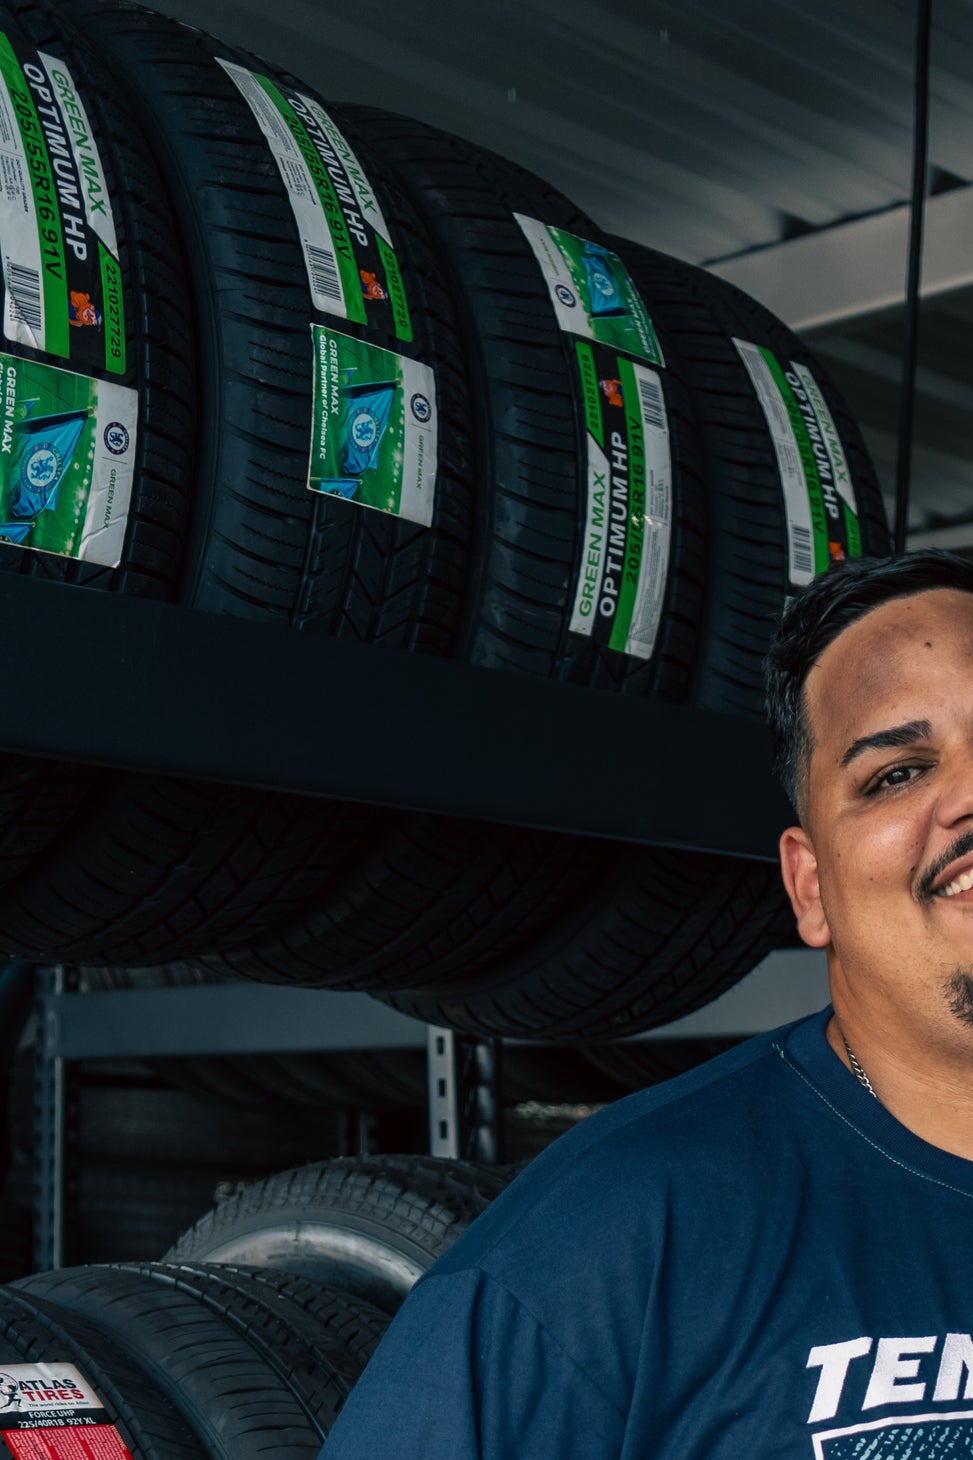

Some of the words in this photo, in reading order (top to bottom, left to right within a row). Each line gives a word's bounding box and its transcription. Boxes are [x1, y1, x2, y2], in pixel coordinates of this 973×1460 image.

[23, 62, 81, 209] OPTIMUM
[63, 212, 88, 261] HP
[52, 69, 92, 151] GREEN
[80, 153, 107, 216] MAX
[310, 105, 355, 165] GREEN
[349, 166, 378, 214] MAX
[11, 87, 56, 222] 205/55R16
[42, 228, 63, 280] 91V
[287, 98, 357, 207] OPTIMUM
[343, 208, 368, 246] HP
[330, 220, 352, 261] 91V
[105, 263, 121, 358] 221027729
[319, 334, 328, 365] Global
[328, 339, 339, 383] GREEN
[5, 366, 17, 418] GREEN
[320, 366, 328, 399] Partner
[330, 385, 340, 415] MAX
[322, 400, 329, 410] of
[1, 420, 14, 454] MAX
[320, 410, 329, 451] Chelsea
[629, 415, 645, 457] 91V
[785, 371, 832, 479] OPTIMUM
[822, 484, 840, 520] HP
[611, 431, 628, 472] HP
[827, 438, 849, 483] MAX
[108, 468, 117, 504] GREEN
[579, 533, 602, 617] GREEN
[591, 471, 606, 528] MAX
[600, 476, 628, 617] OPTIMUM
[18, 1379, 77, 1391] ATLAS
[22, 1389, 85, 1402] TIRES
[18, 1419, 65, 1428] 225/40R18
[66, 1417, 83, 1426] 92Y
[29, 1410, 58, 1418] FORCE
